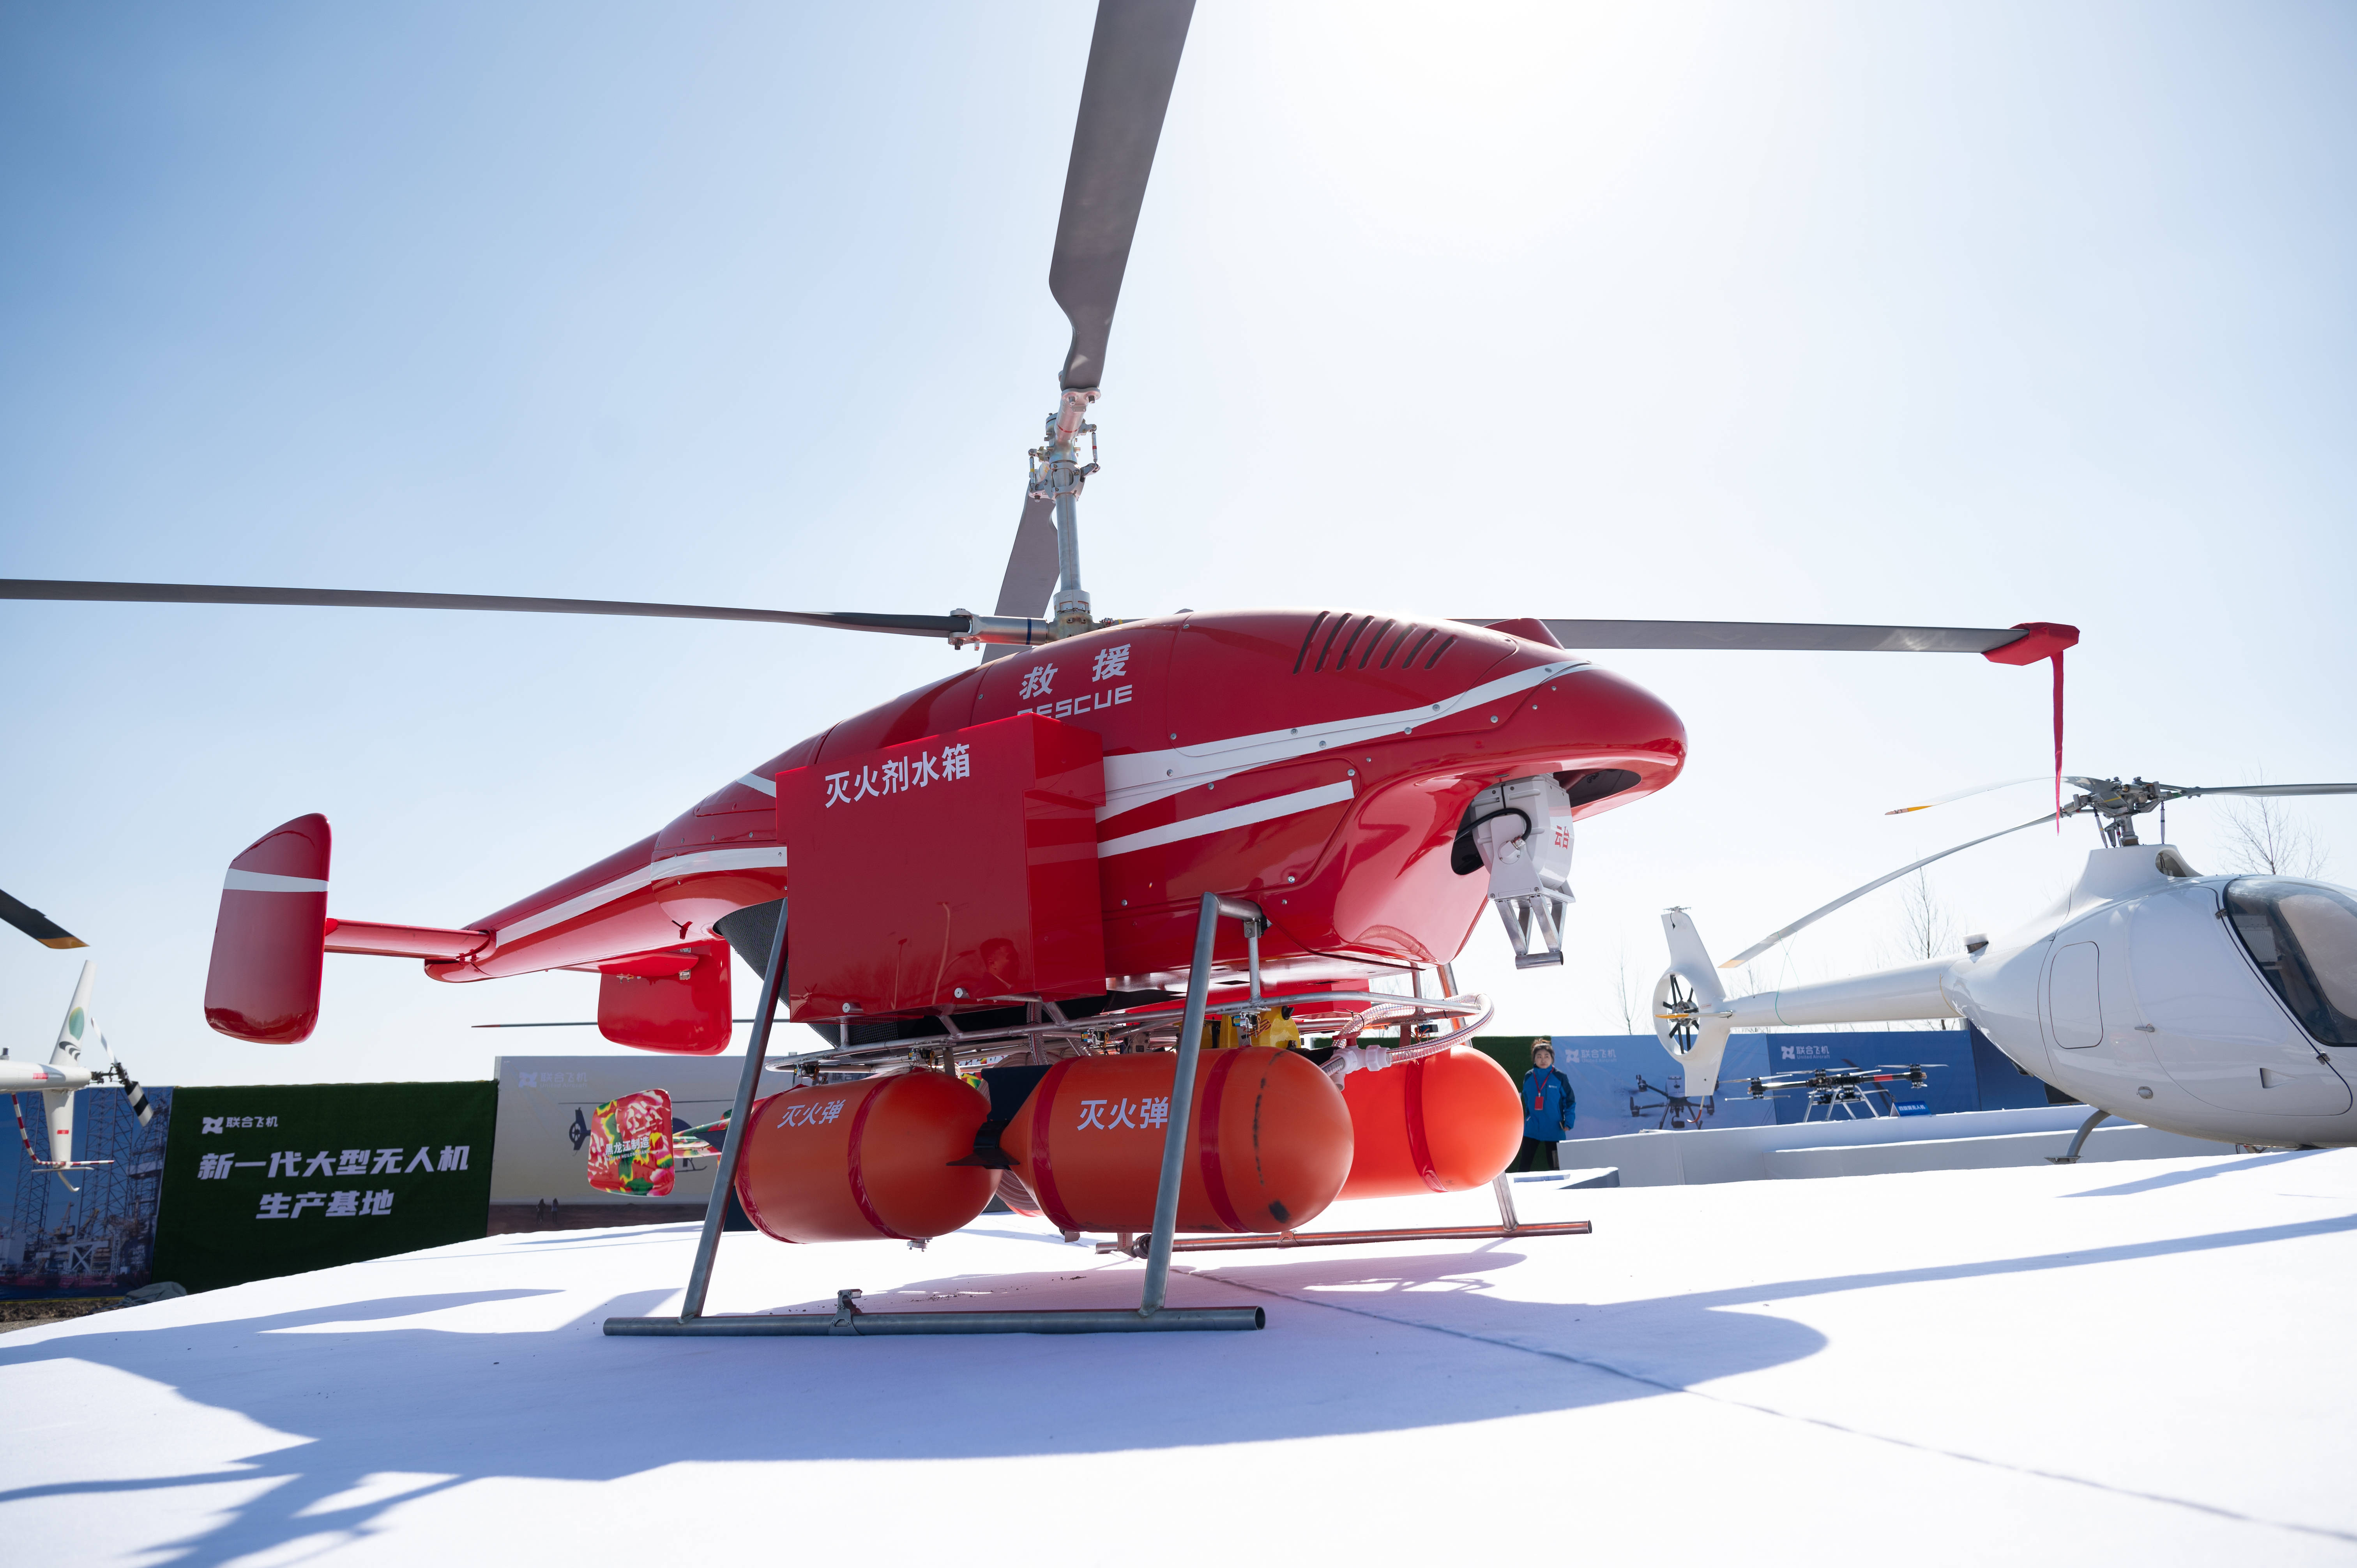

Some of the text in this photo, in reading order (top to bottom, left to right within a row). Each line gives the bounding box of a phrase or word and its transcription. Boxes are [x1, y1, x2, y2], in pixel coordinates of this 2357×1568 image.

[825, 743, 970, 809] 灭火剂水箱
[1581, 1049, 1616, 1058] 联合飞机
[1796, 1046, 1829, 1054] 联合飞机
[540, 1072, 587, 1082] 联合飞机
[226, 1116, 278, 1128] 联合飞机
[777, 1099, 846, 1129] 灭火弹
[1077, 1097, 1168, 1131] 灭火弹
[606, 1136, 650, 1156] 黑龙江制造
[197, 1145, 470, 1180] 新一代大型无人机
[256, 1189, 394, 1219] 生产基地
